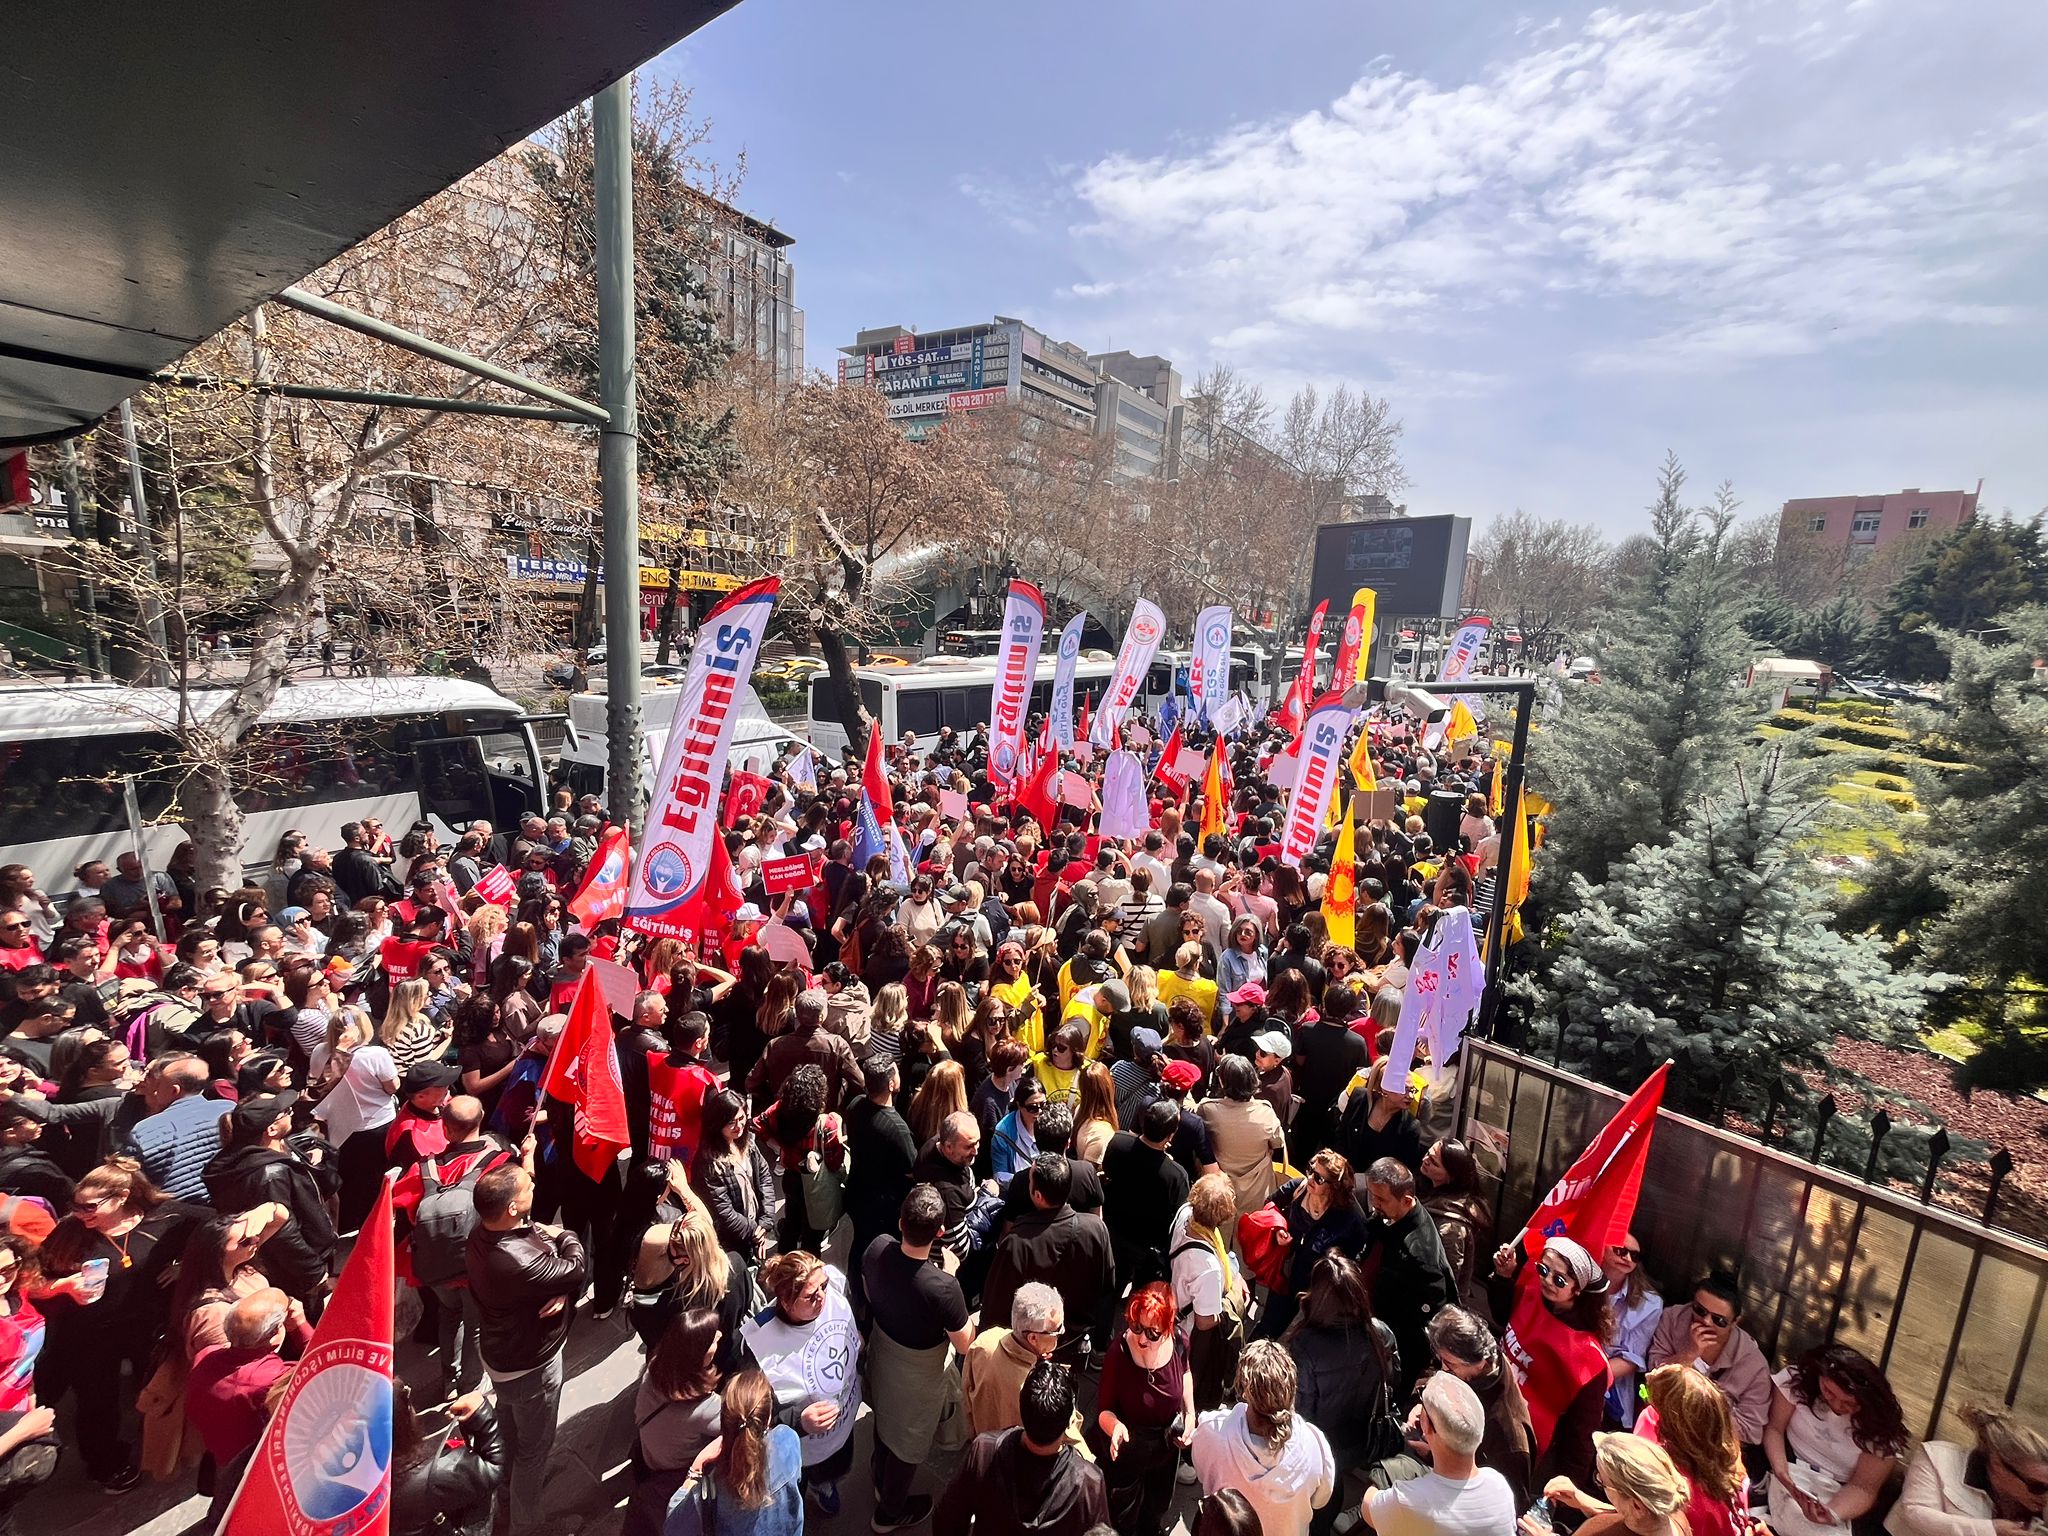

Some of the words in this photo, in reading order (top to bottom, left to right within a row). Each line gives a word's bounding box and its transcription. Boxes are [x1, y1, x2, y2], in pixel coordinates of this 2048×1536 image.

[986, 334, 1007, 344] KPSS
[988, 347, 1005, 356] YDS
[986, 359, 1006, 370] ALES
[986, 371, 1004, 381] DGS
[956, 395, 970, 407] 530
[971, 394, 984, 405] 287
[694, 576, 718, 588] TIME
[1206, 669, 1217, 698] EGS
